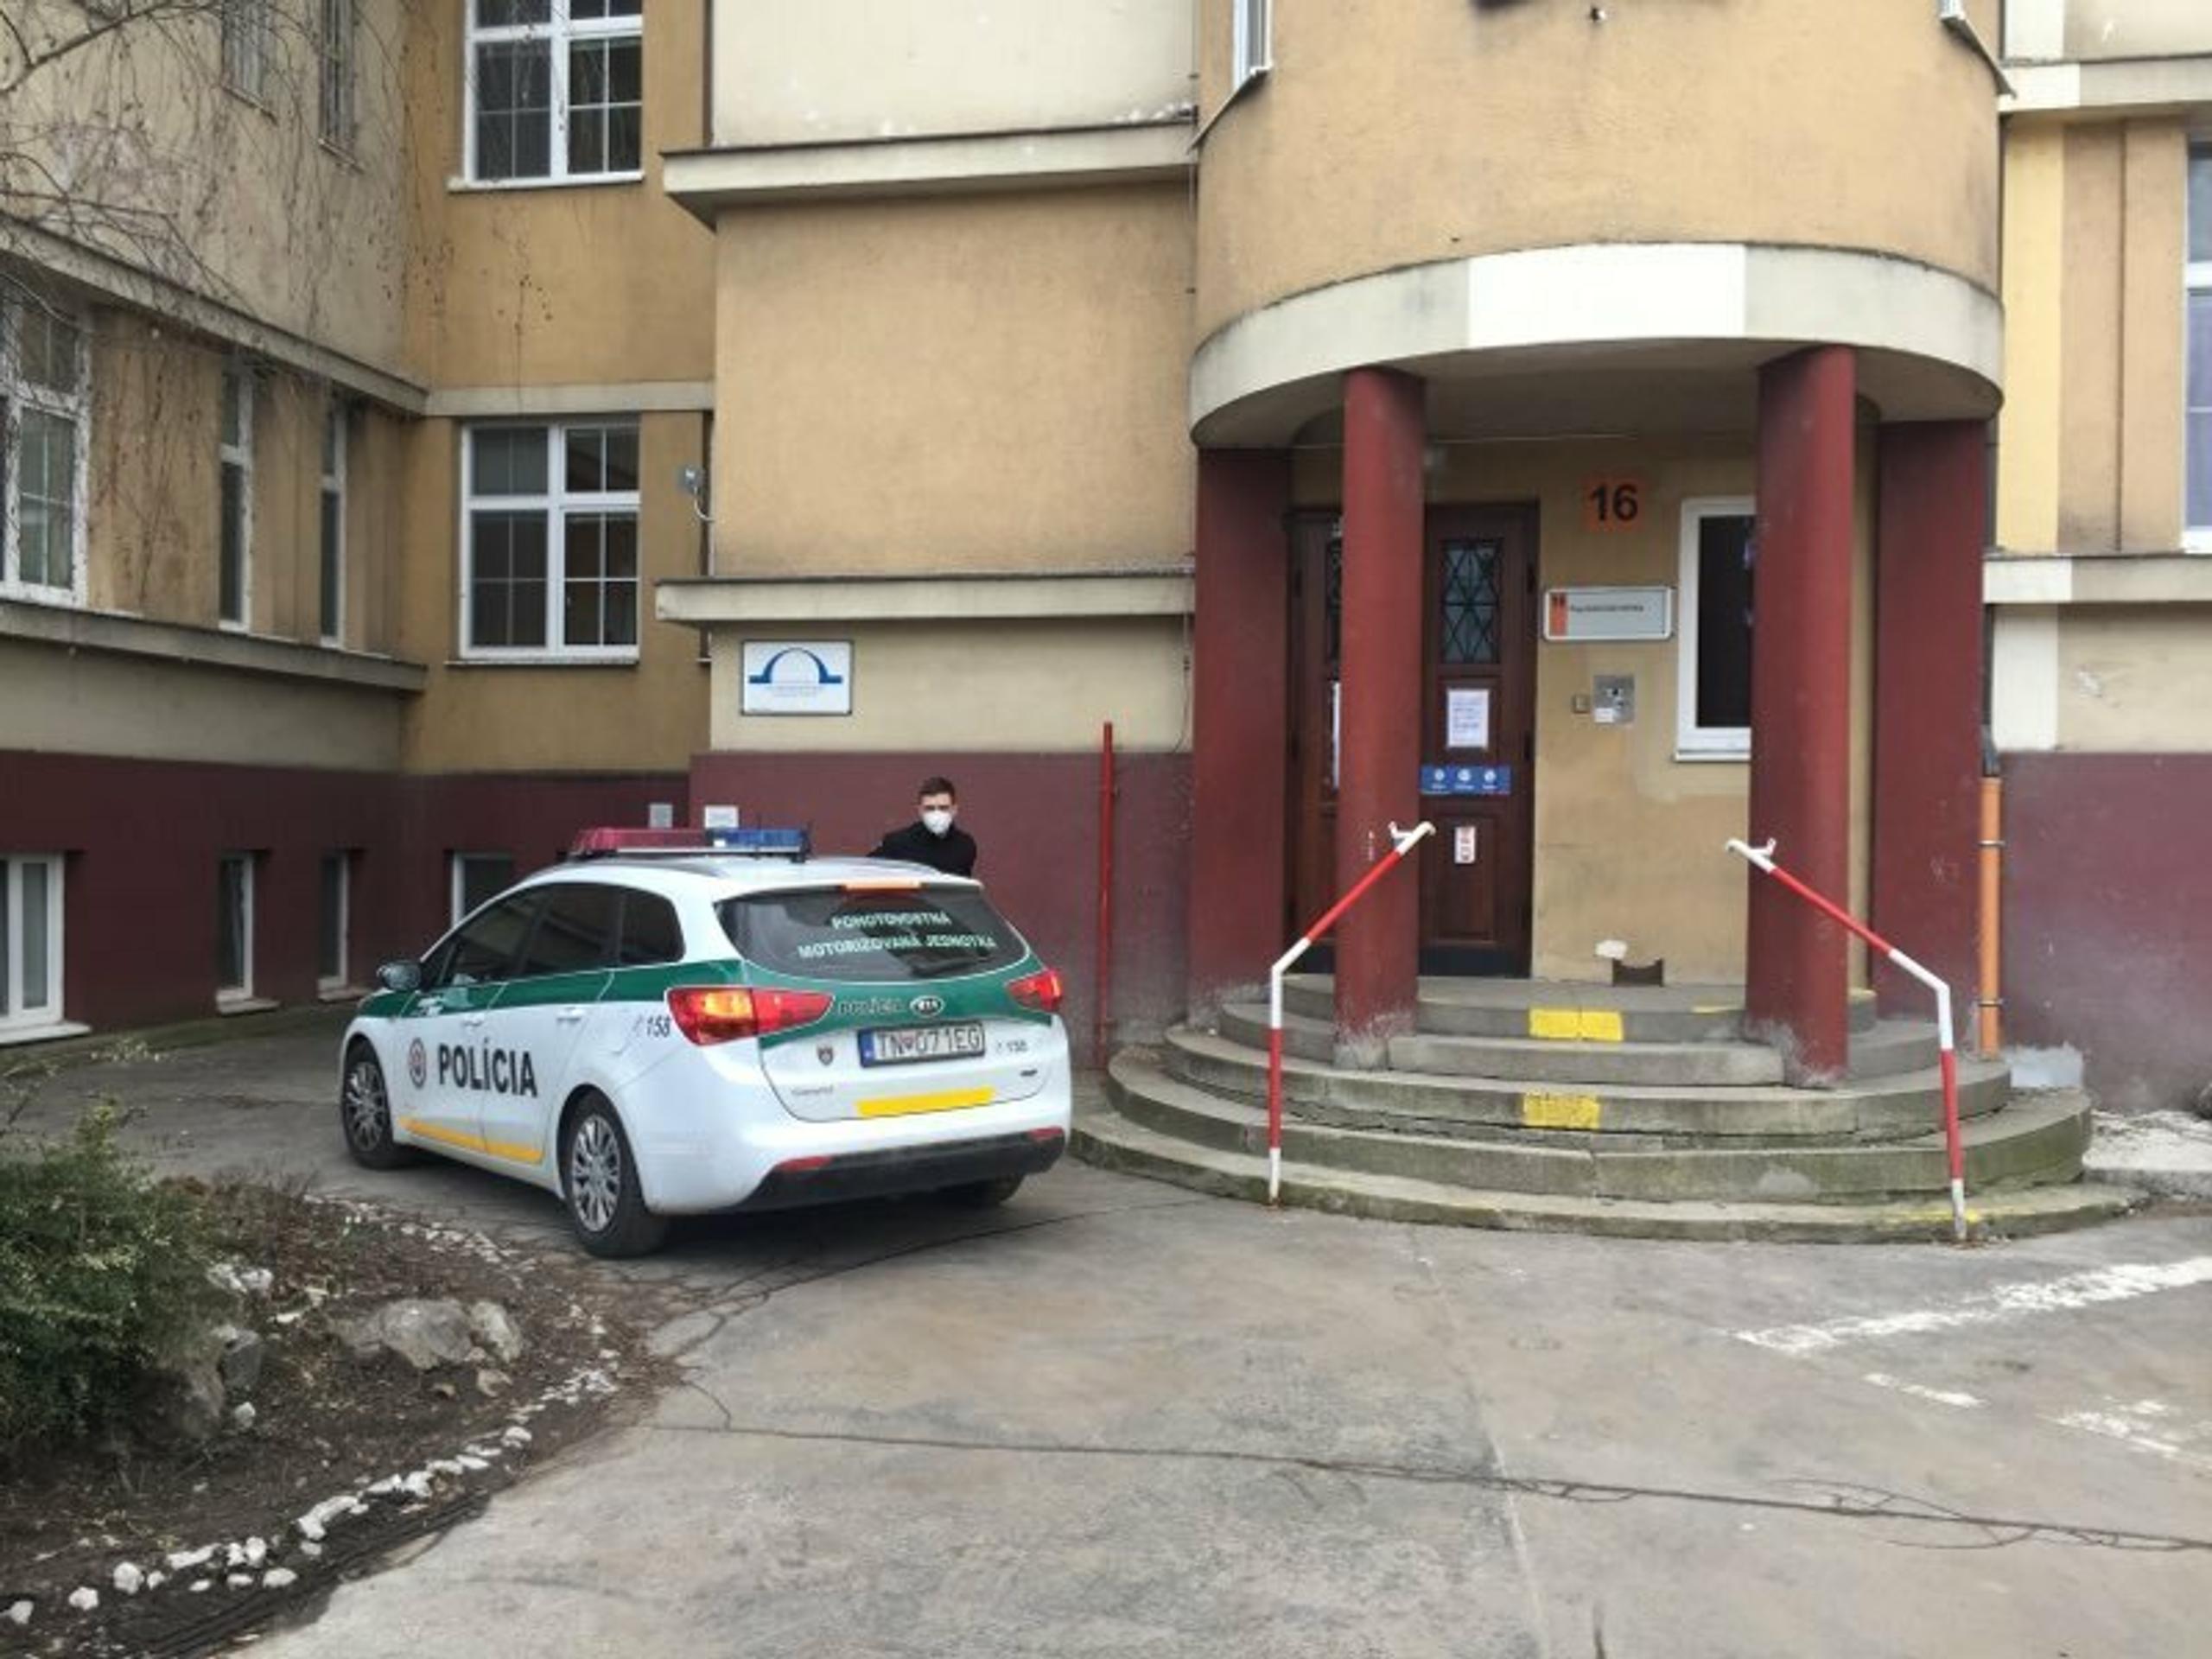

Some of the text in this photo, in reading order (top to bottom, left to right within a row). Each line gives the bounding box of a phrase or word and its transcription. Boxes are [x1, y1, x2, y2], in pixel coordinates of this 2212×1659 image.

[1592, 483, 1638, 522] 16
[646, 1014, 672, 1038] 158
[438, 1038, 537, 1097] POLÍCIA
